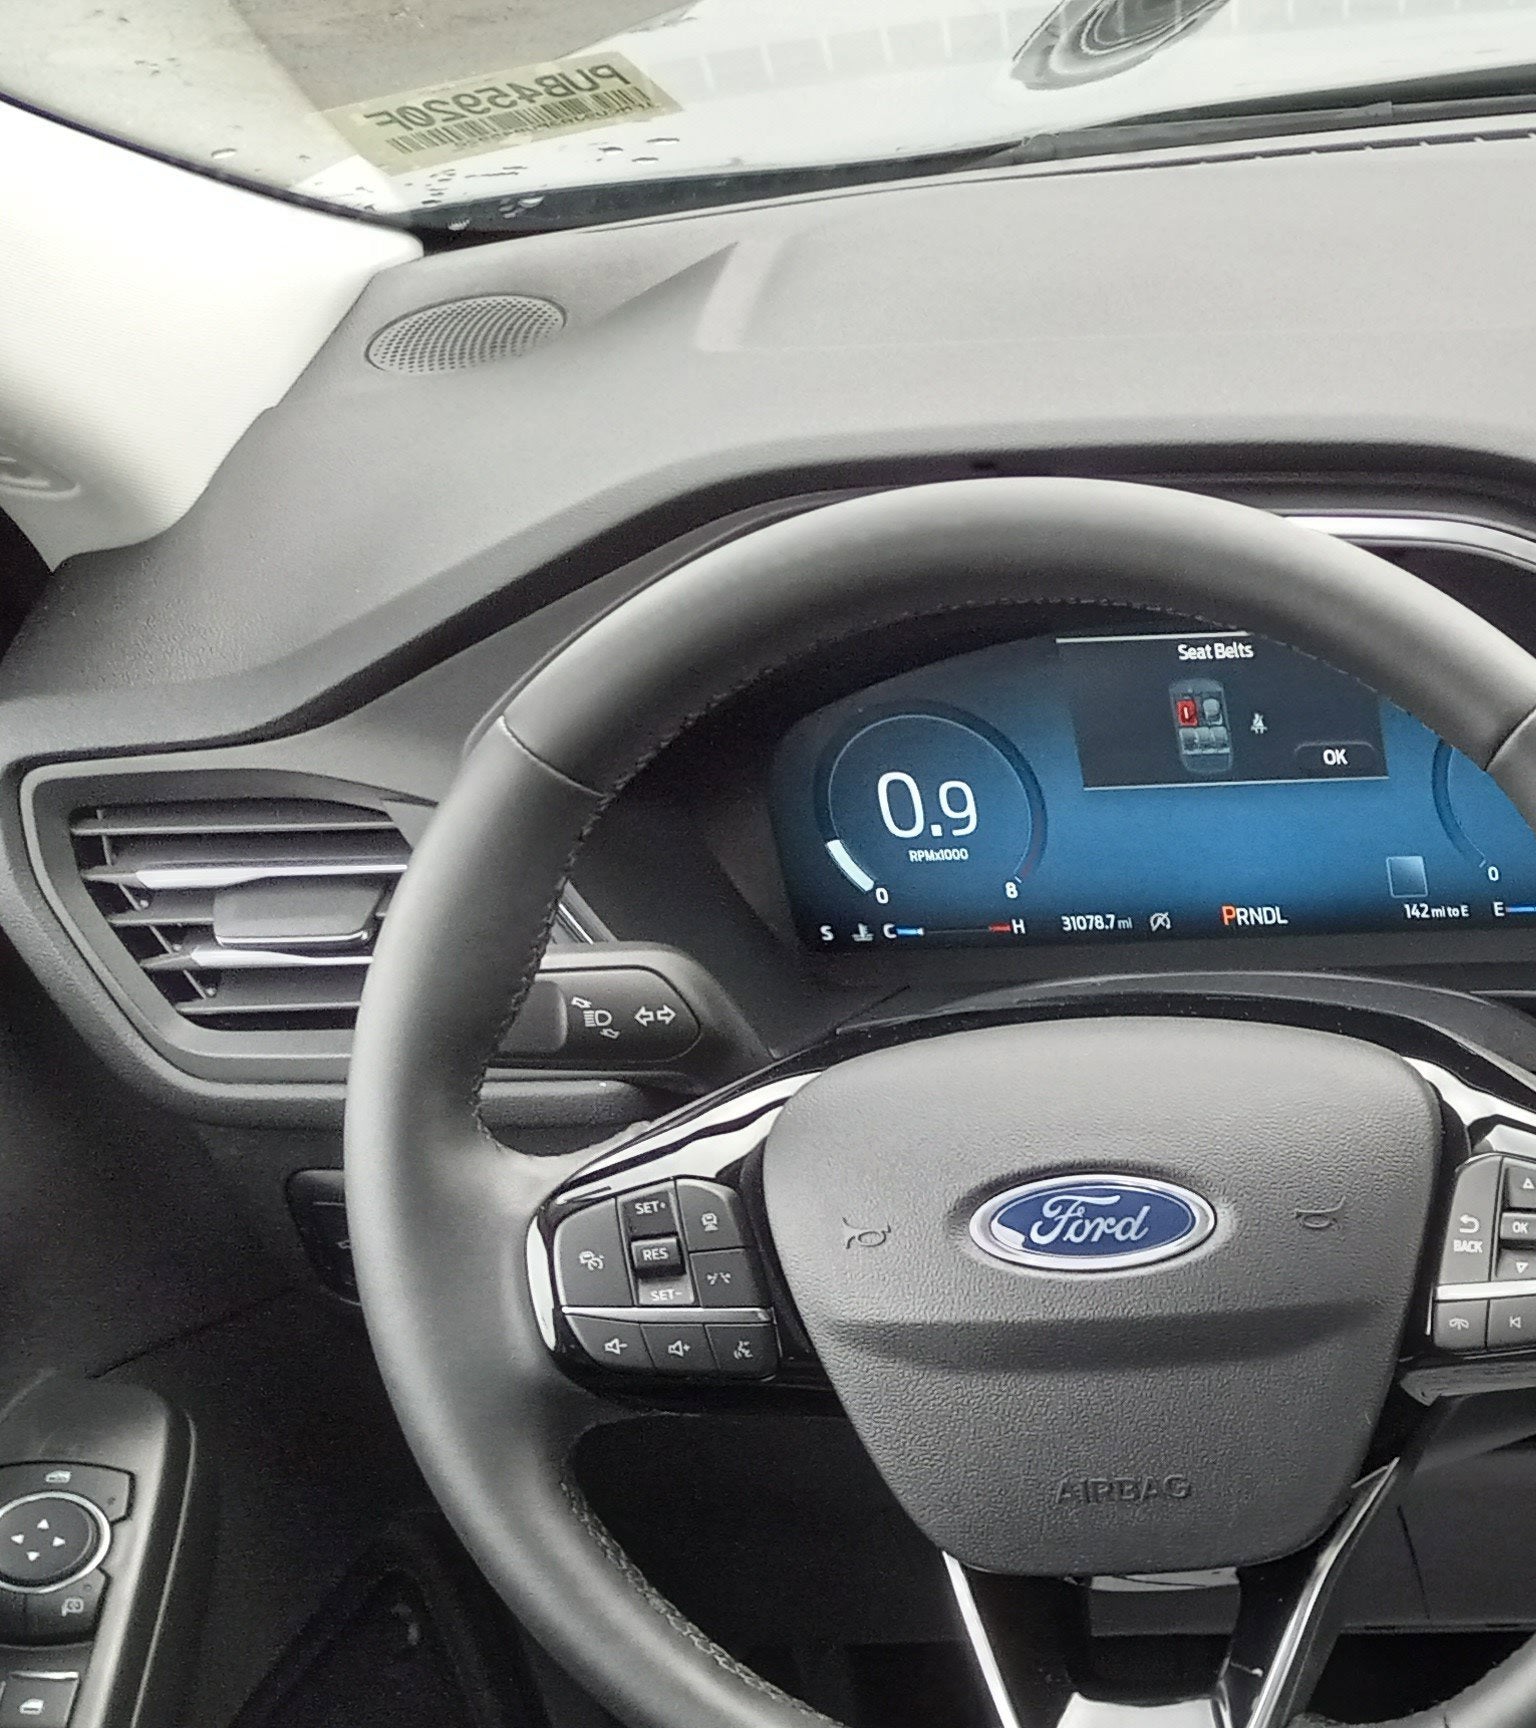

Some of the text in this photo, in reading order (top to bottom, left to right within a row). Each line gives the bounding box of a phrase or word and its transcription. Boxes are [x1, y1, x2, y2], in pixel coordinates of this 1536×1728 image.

[1177, 641, 1254, 661] Seat Belts
[1322, 748, 1349, 766] OK
[877, 771, 977, 838] 0.9
[1487, 866, 1499, 882] 0
[875, 887, 889, 904] 0
[1005, 881, 1019, 899] 8
[1221, 904, 1289, 927] PRNDL
[1404, 903, 1470, 919] 142 mi to E
[1493, 901, 1505, 917] E
[1011, 918, 1026, 935] H
[1061, 914, 1134, 932] 31078.7 mi
[1029, 1194, 1150, 1246] Ford
[1512, 1221, 1529, 1235] OK
[641, 1247, 670, 1262] RES
[1453, 1239, 1483, 1254] BACK
[1054, 1473, 1193, 1505] AIRBAG
